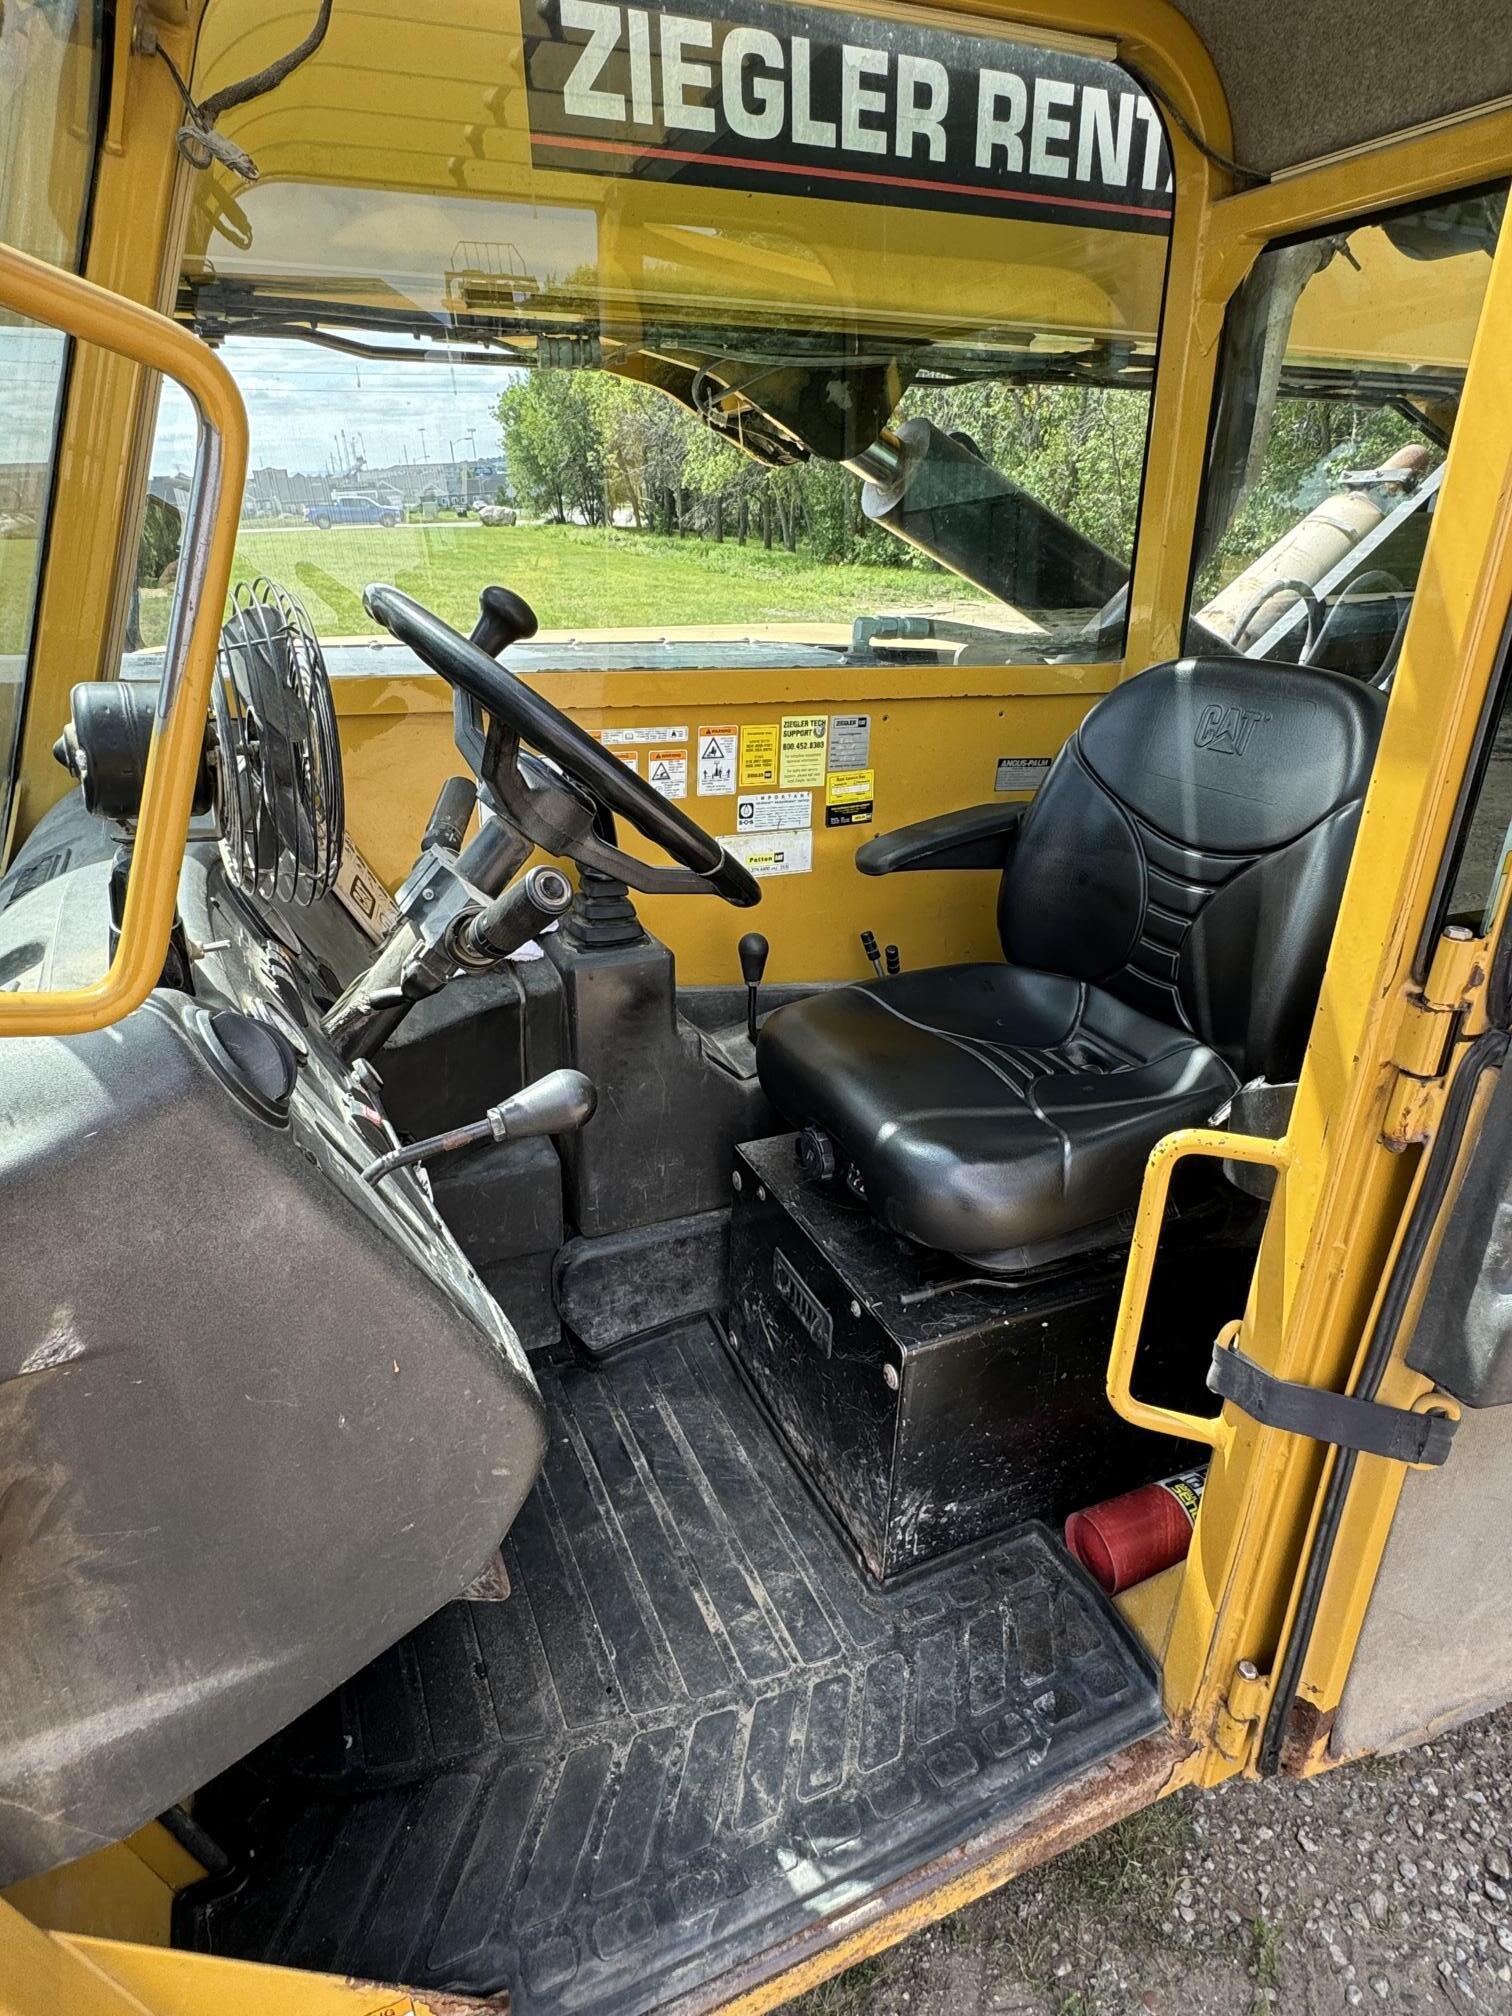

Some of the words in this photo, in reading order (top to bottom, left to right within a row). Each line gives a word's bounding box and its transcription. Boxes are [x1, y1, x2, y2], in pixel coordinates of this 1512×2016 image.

[560, 0, 949, 163] ZIEGLER
[975, 68, 1174, 193] RENT
[783, 719, 809, 729] ZIEGLER
[810, 719, 826, 727] TECH
[783, 729, 813, 738] SUPPORT
[1194, 704, 1263, 756] CAT
[749, 855, 773, 863] Patton
